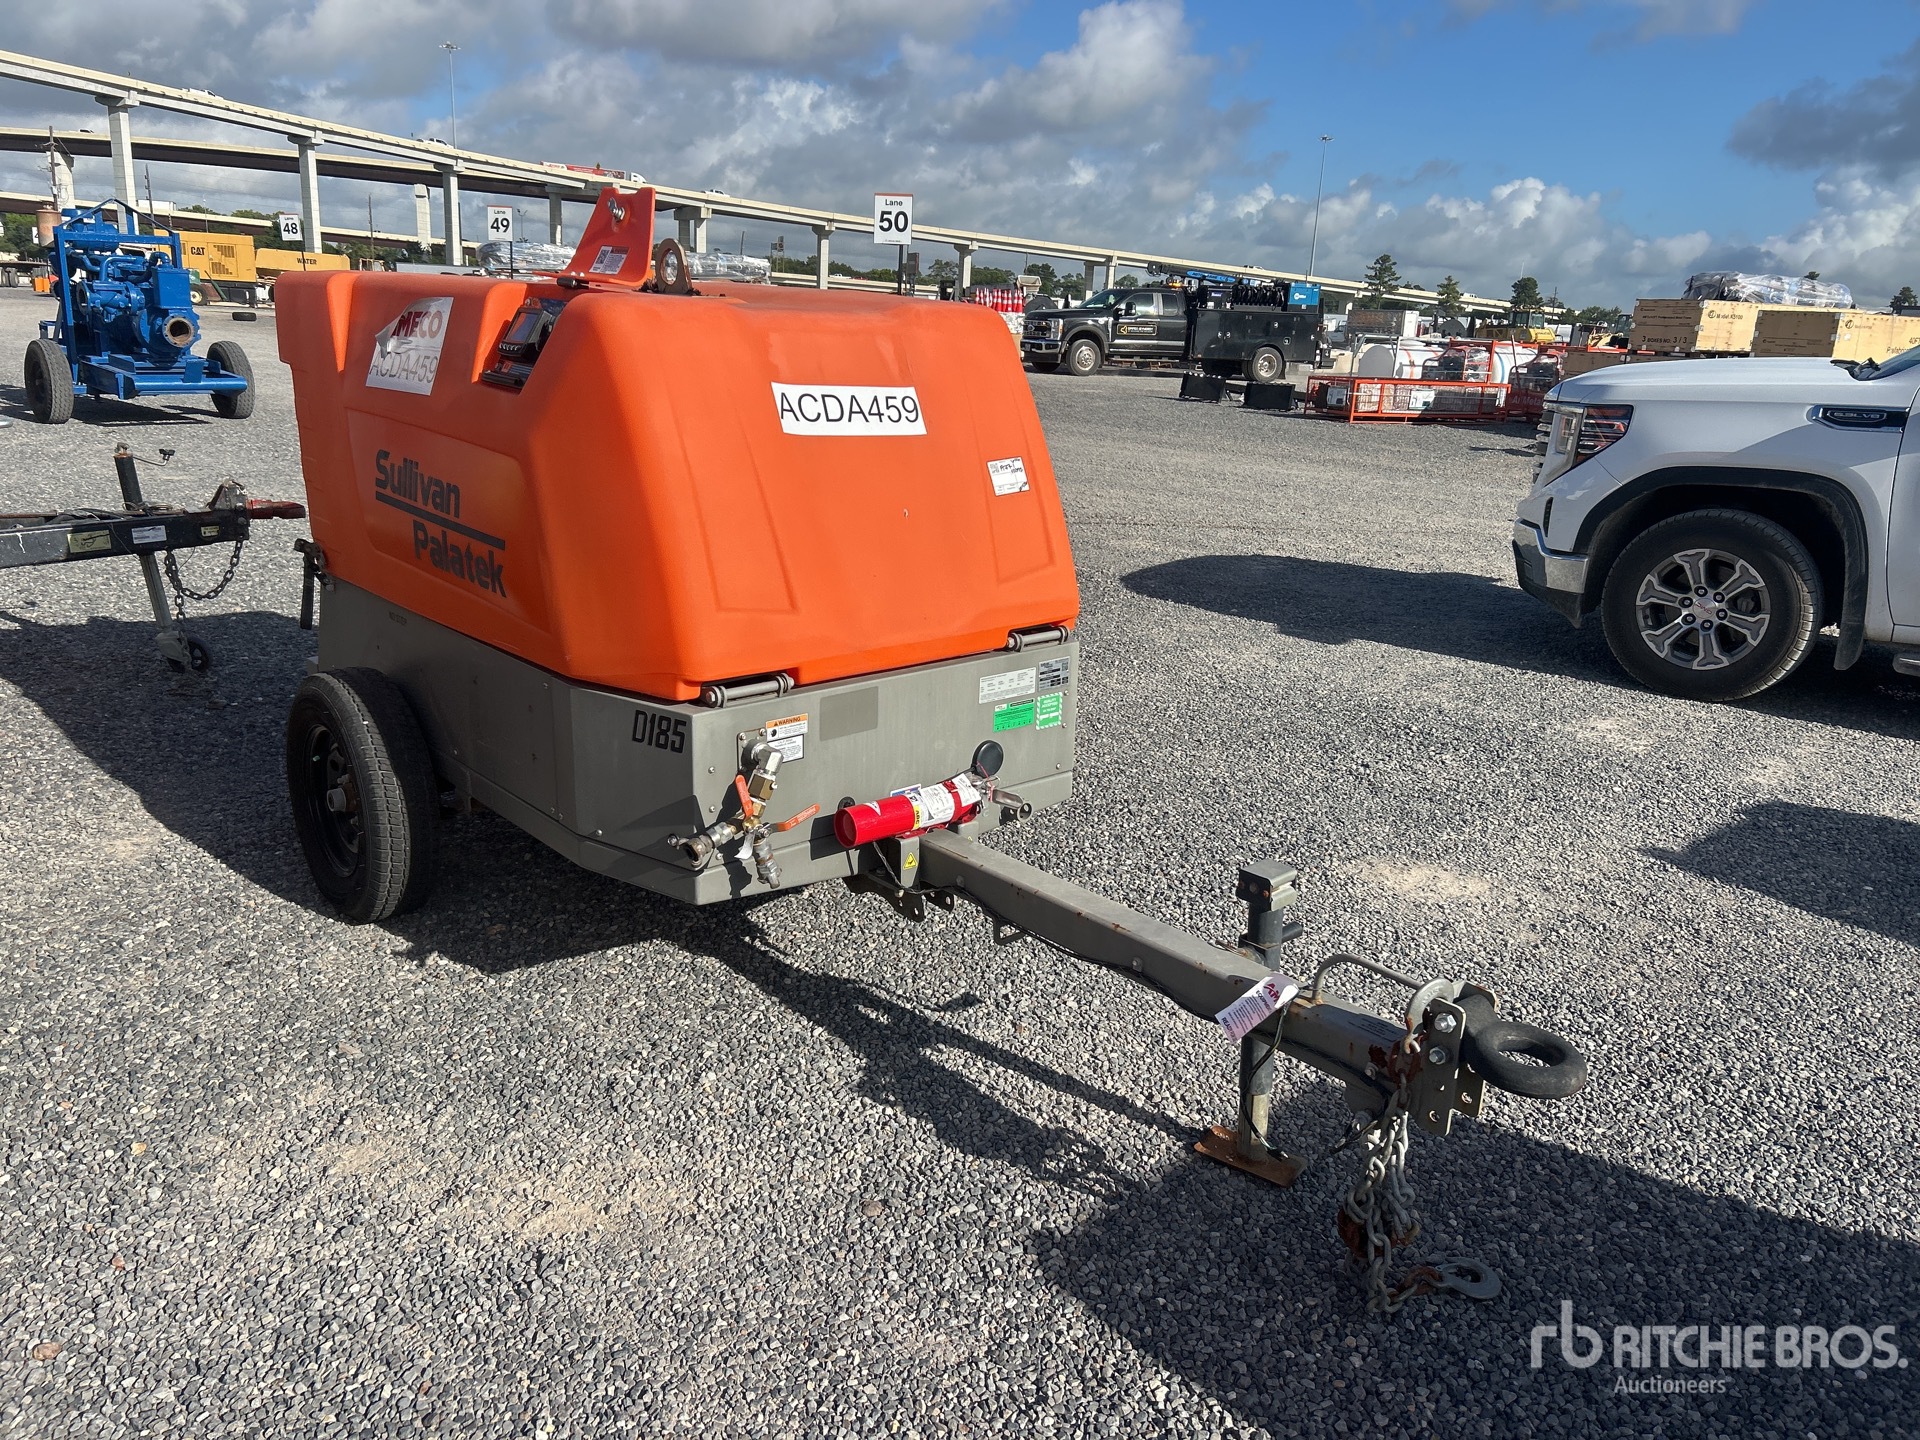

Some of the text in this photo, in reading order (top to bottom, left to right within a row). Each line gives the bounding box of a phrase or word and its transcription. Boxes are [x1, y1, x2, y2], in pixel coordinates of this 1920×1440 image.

[283, 222, 298, 234] 48
[491, 217, 510, 232] 49
[879, 211, 908, 232] 50
[190, 246, 205, 256] CAT
[369, 353, 439, 384] ACDA459
[780, 392, 919, 423] ACDA459
[376, 449, 460, 518] Sullivan
[412, 520, 507, 598] Palatek
[1696, 602, 1712, 615] GMC
[779, 716, 801, 725] WARNING
[632, 710, 686, 753] D185
